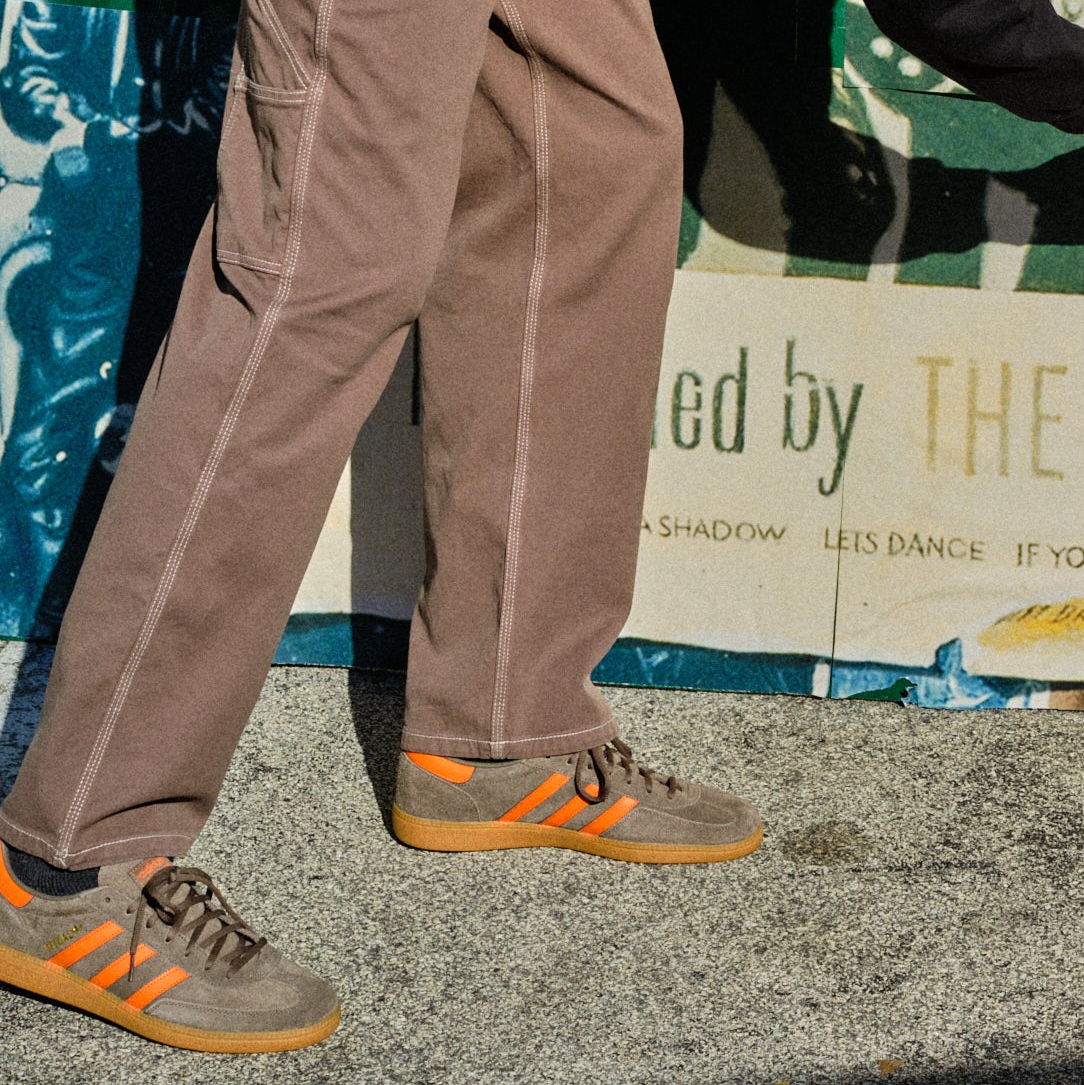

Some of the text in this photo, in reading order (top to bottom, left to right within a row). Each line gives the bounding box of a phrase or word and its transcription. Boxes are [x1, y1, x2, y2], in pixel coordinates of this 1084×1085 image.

[651, 344, 749, 454] ed
[782, 336, 864, 497] by
[916, 356, 1068, 481] THE
[658, 515, 786, 542] SHADOW
[888, 532, 985, 562] DANCE
[1018, 543, 1040, 568] IF
